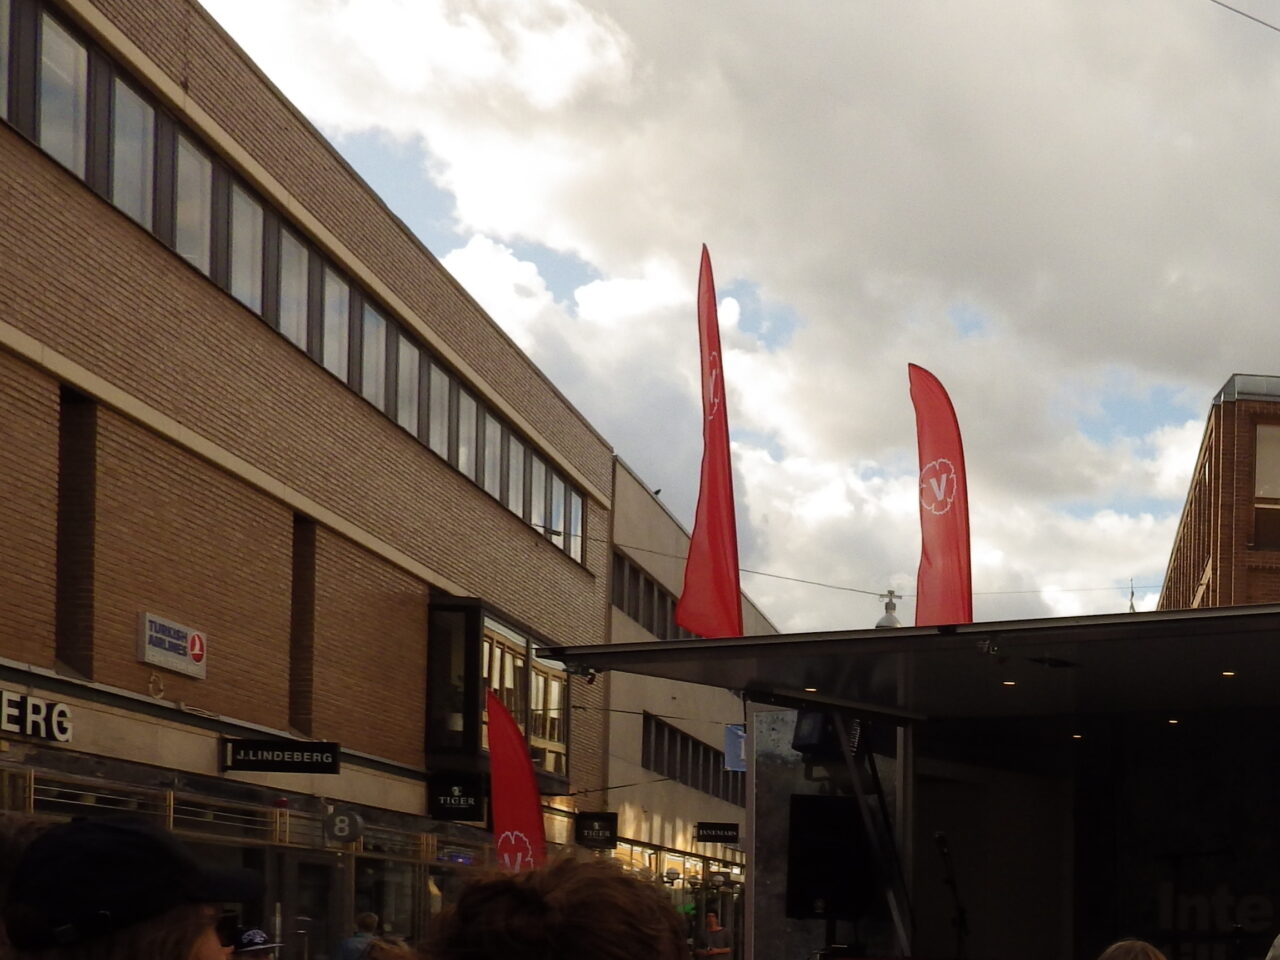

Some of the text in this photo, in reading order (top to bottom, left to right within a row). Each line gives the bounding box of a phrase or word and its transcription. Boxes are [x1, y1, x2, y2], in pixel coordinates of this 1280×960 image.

[929, 473, 947, 502] V
[148, 620, 188, 642] TURKISH
[148, 634, 188, 658] AIRLINES
[1, 690, 73, 743] ERG
[236, 750, 333, 763] J.LINDEBERG
[438, 796, 476, 806] TIGER
[334, 816, 350, 836] 8
